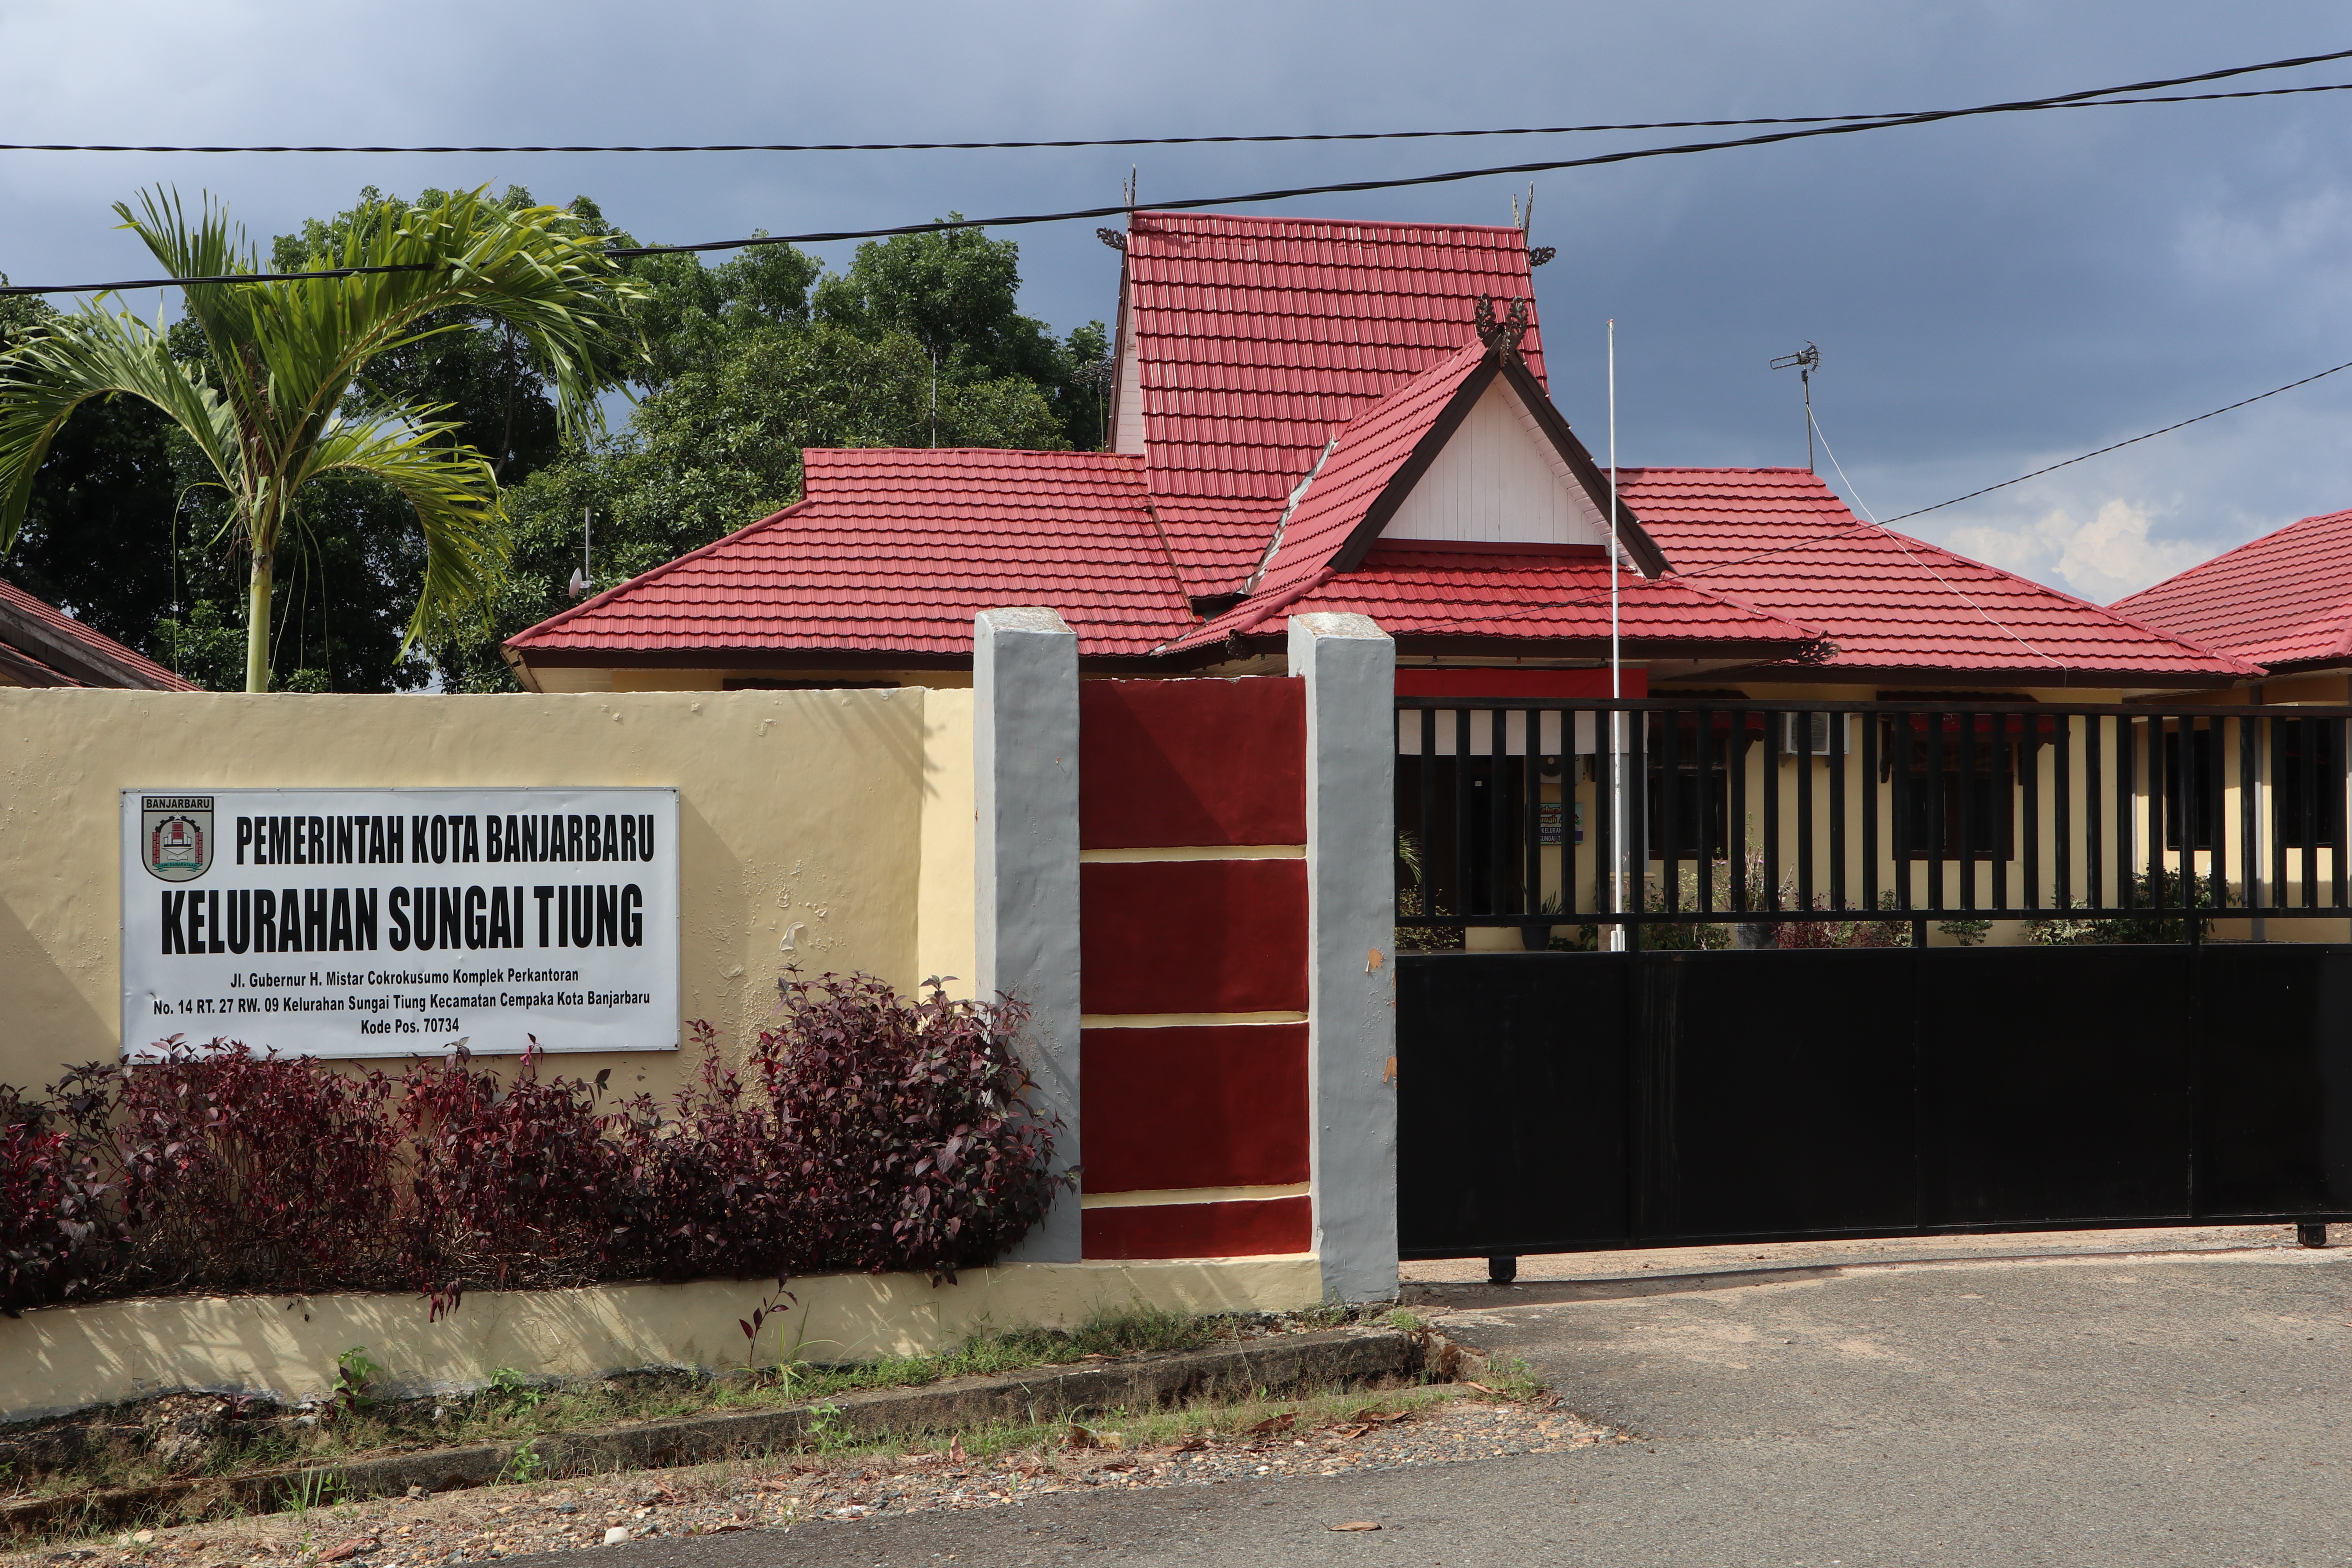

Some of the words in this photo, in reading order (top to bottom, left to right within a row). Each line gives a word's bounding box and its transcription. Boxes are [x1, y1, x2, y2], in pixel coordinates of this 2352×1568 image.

[146, 799, 210, 808] BANJARBARU
[236, 815, 403, 865] PEMERINTAH
[412, 815, 479, 864] KOTA
[486, 814, 654, 862] BANJARBARU
[162, 887, 377, 955] KELURAHAN
[388, 885, 523, 951] SUNGAI
[534, 884, 642, 948] TIUNG
[230, 973, 245, 988] Jl.
[249, 973, 306, 987] Gubernur
[310, 972, 322, 986] H.
[327, 971, 364, 986] Mistar
[368, 970, 449, 985] Cokrokusumo
[453, 968, 504, 987] Komplek
[508, 968, 578, 982] Perkantoran
[154, 1000, 173, 1015] No.
[178, 999, 192, 1014] 14
[197, 999, 215, 1014] RT.
[219, 998, 234, 1013] 27
[238, 998, 260, 1013] RW.
[265, 997, 279, 1012] 09
[283, 996, 344, 1012] Kelurahan
[348, 995, 389, 1013] Sungai
[393, 995, 426, 1012] Tiung
[430, 993, 496, 1008] Kecamatan
[500, 991, 554, 1010] Cempaka
[557, 991, 583, 1005] Kota
[588, 990, 650, 1008] Banjarbaru
[361, 1019, 391, 1034] Kode
[395, 1019, 419, 1033] Pos.
[424, 1017, 459, 1033] 70734
